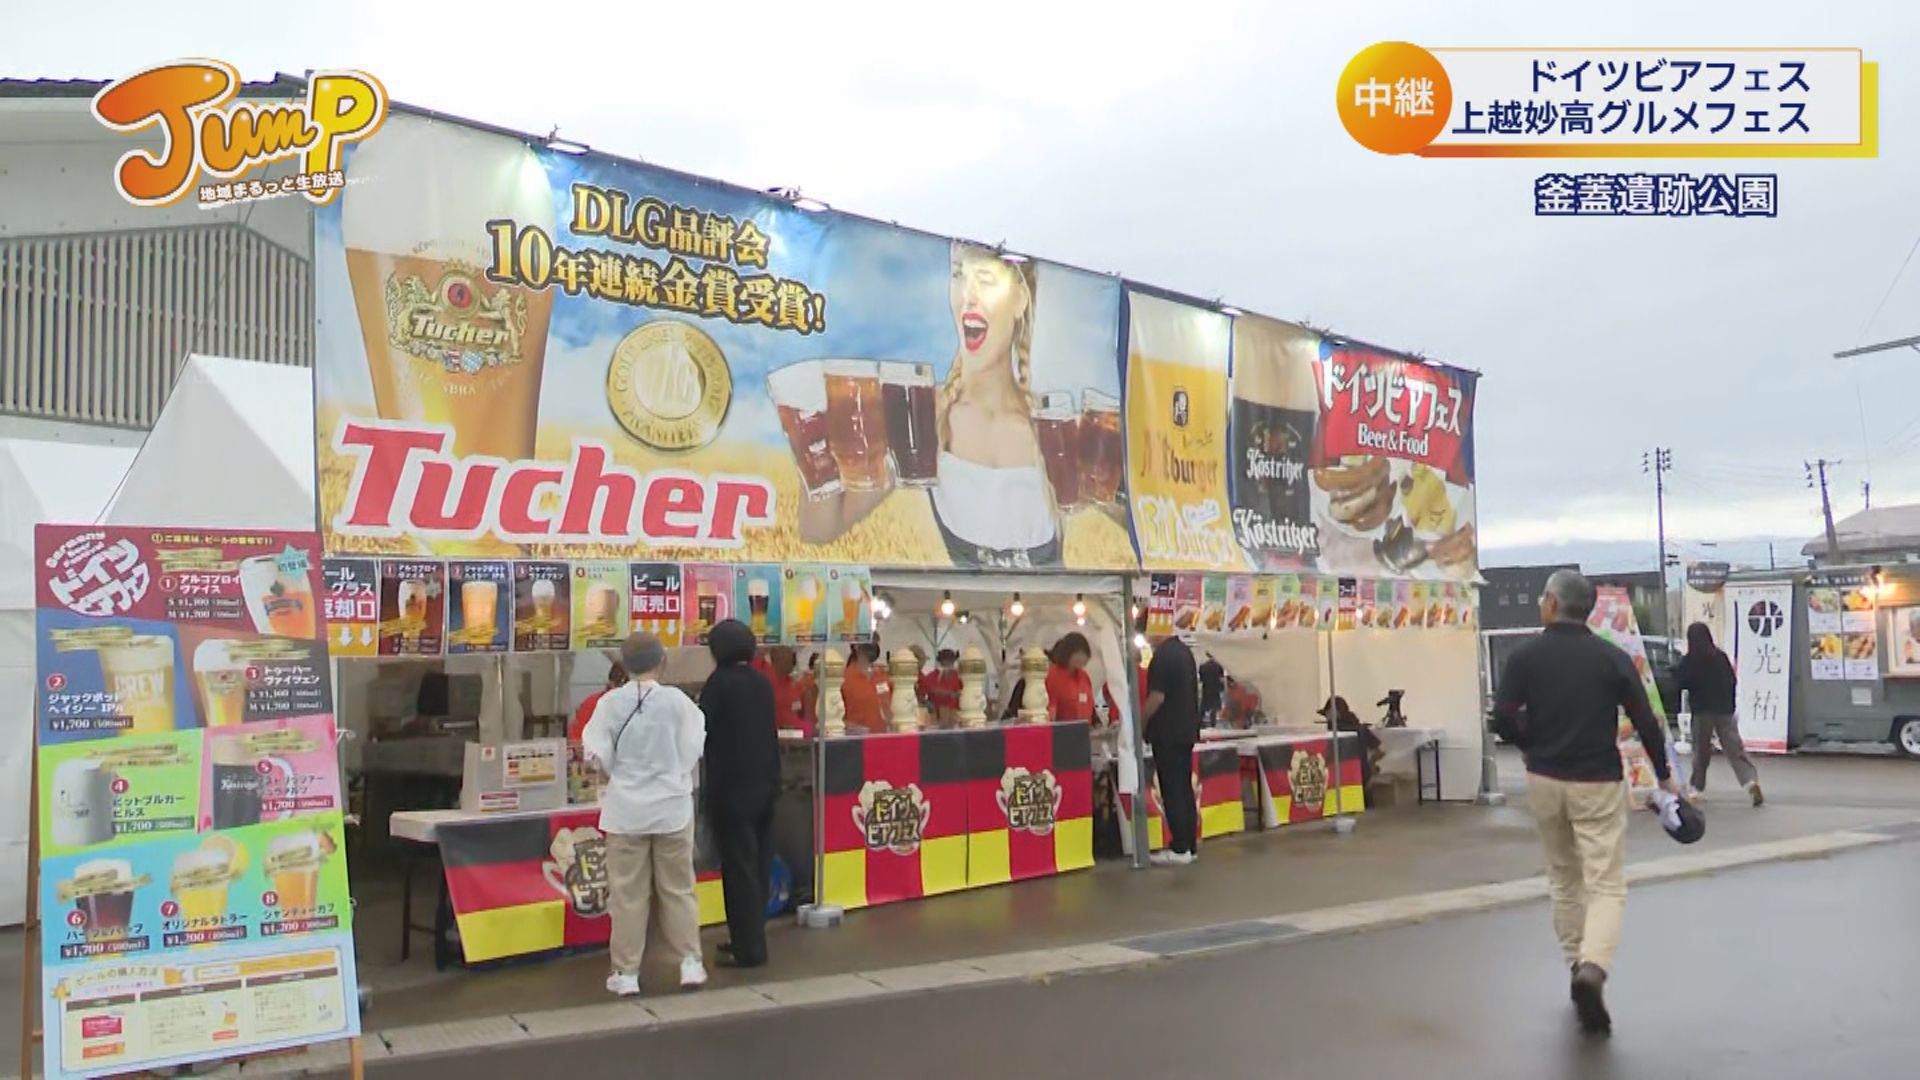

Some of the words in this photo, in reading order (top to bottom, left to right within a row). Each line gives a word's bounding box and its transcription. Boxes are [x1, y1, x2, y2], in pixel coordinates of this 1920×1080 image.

[571, 183, 771, 269] DLG品評会
[411, 313, 510, 346] Tucher
[1321, 356, 1463, 436] ドイツビアフェス
[335, 418, 774, 546] Tucher
[324, 567, 356, 581] ール
[633, 574, 680, 592] ビール
[332, 582, 375, 597] グラス
[632, 594, 681, 613] 販売口
